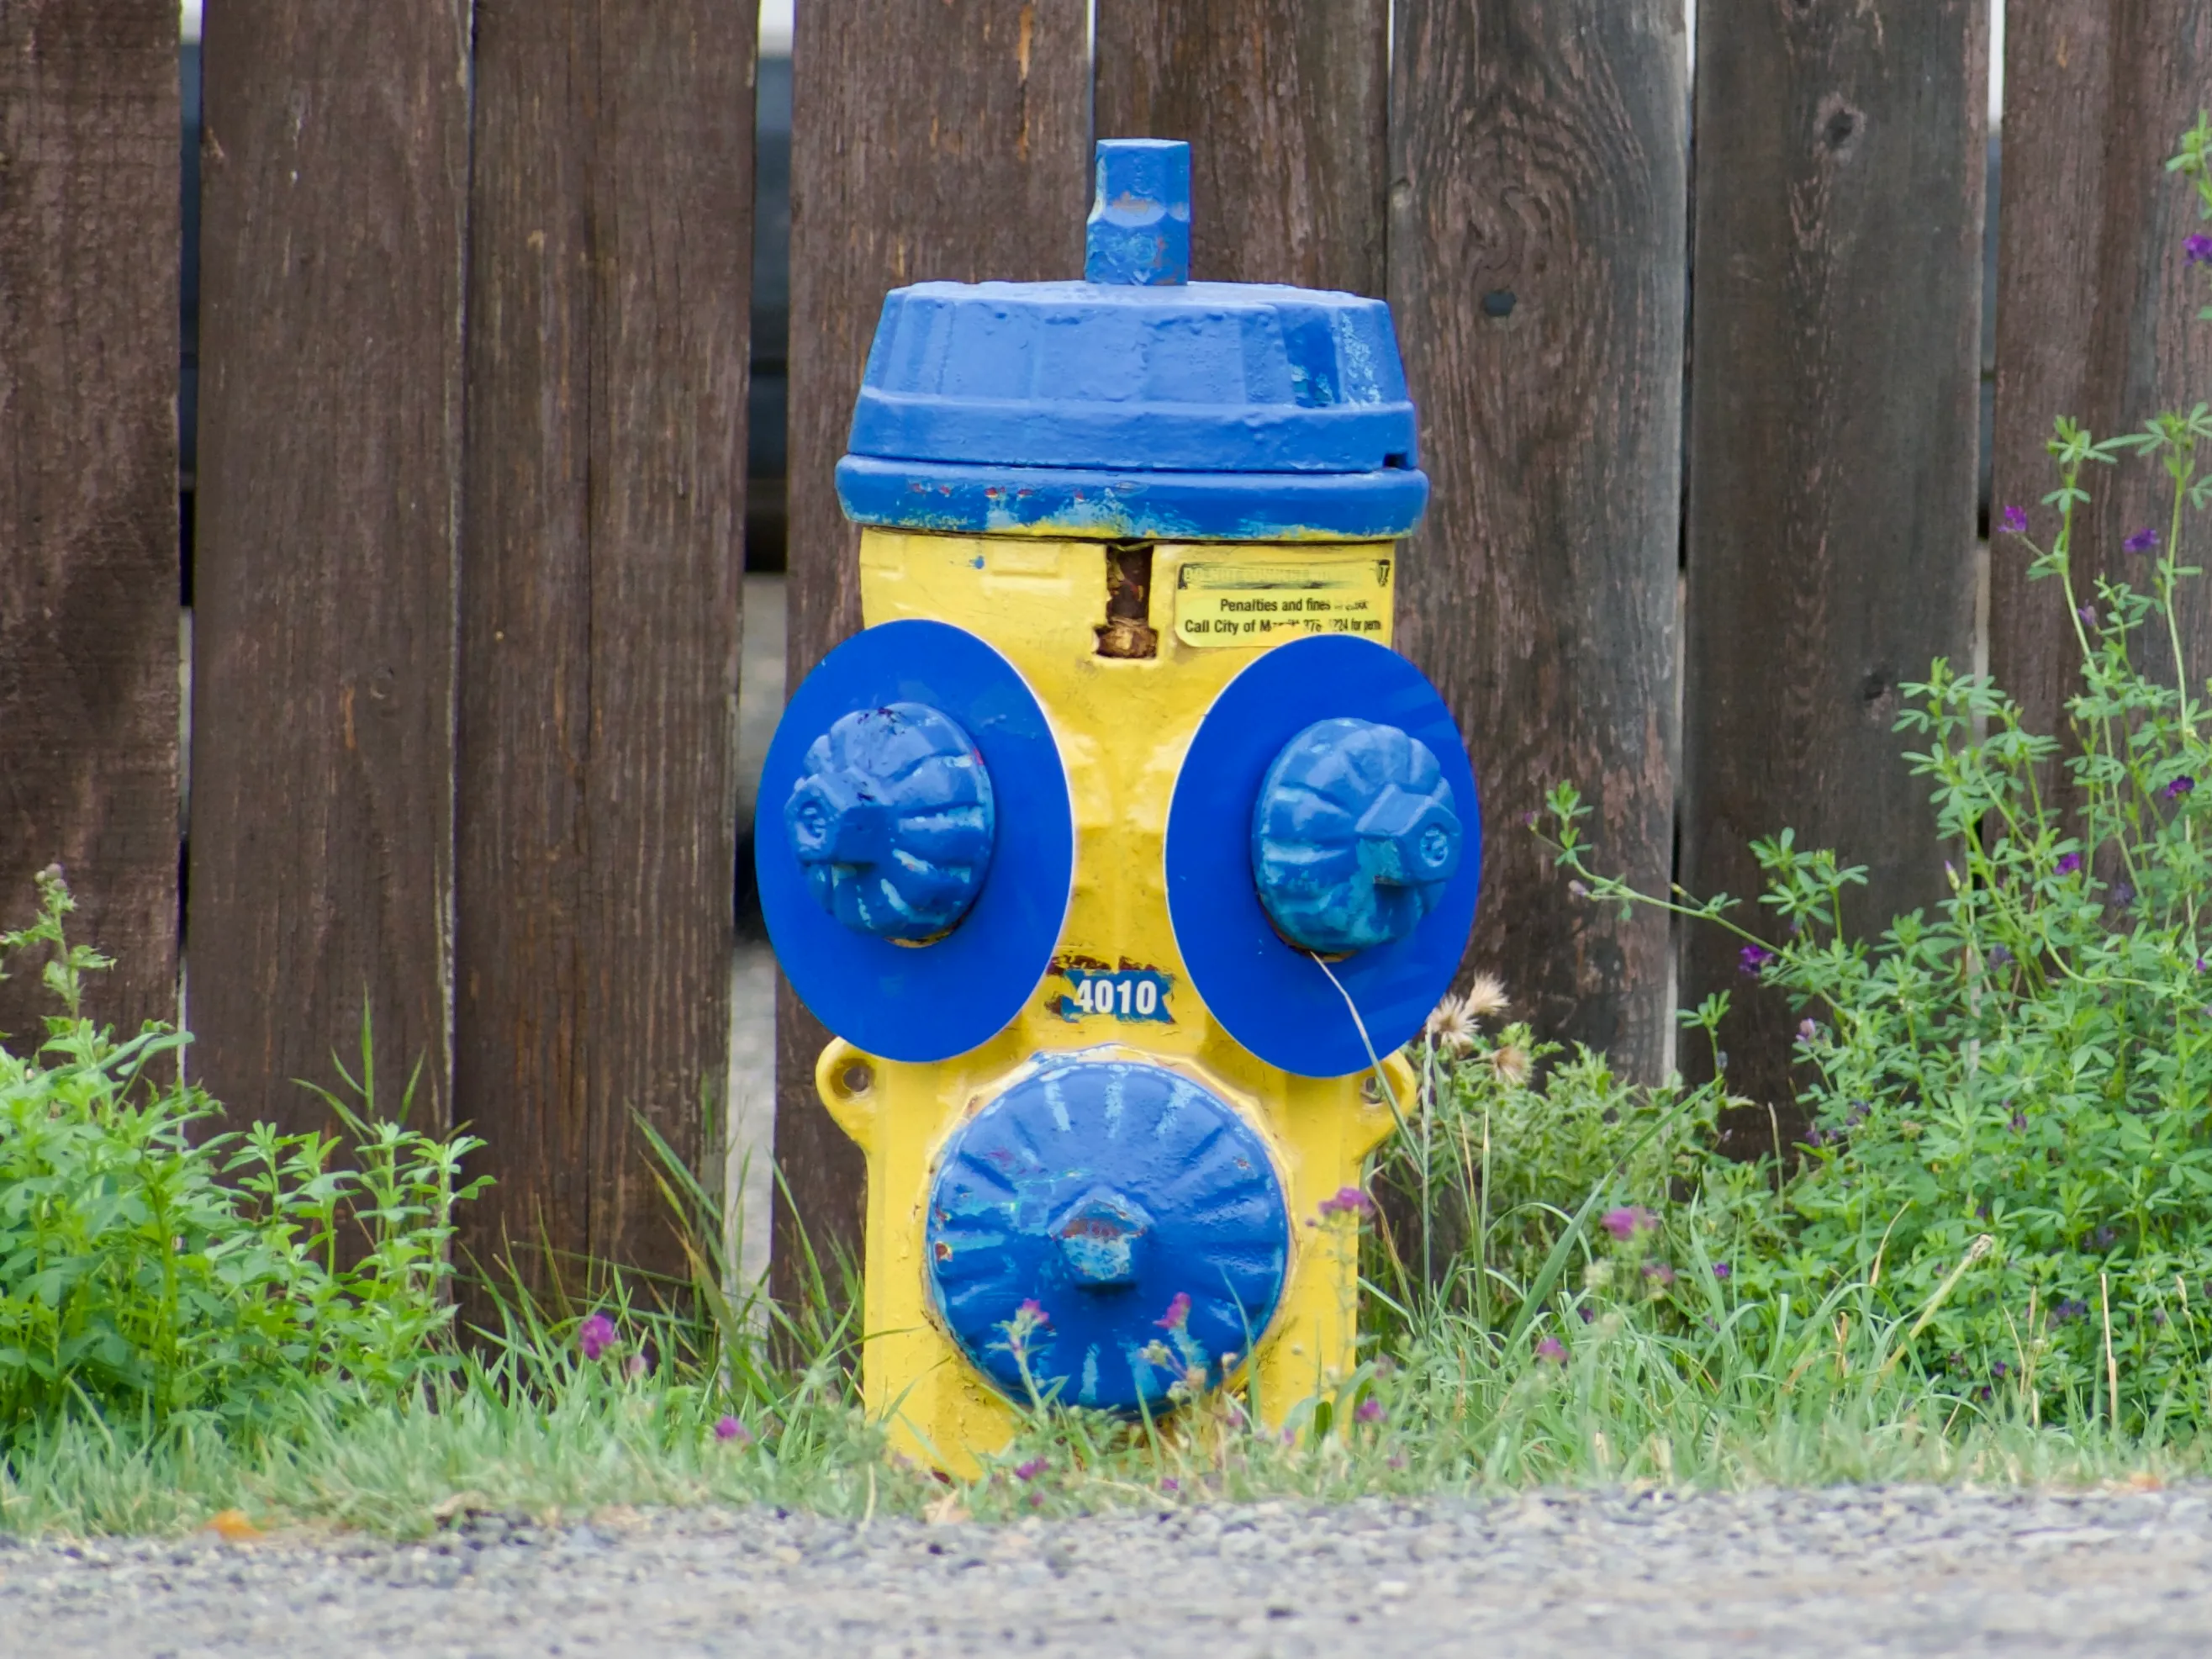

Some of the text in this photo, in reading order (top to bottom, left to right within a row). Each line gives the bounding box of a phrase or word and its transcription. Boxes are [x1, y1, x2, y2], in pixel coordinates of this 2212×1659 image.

[1221, 598, 1280, 611] Penalties
[1282, 598, 1302, 611] and
[1307, 598, 1330, 611] fines
[1185, 619, 1209, 633] Call
[1214, 619, 1238, 637] City
[1243, 618, 1256, 632] of
[1351, 617, 1363, 631] for
[1073, 979, 1157, 1015] 4010
